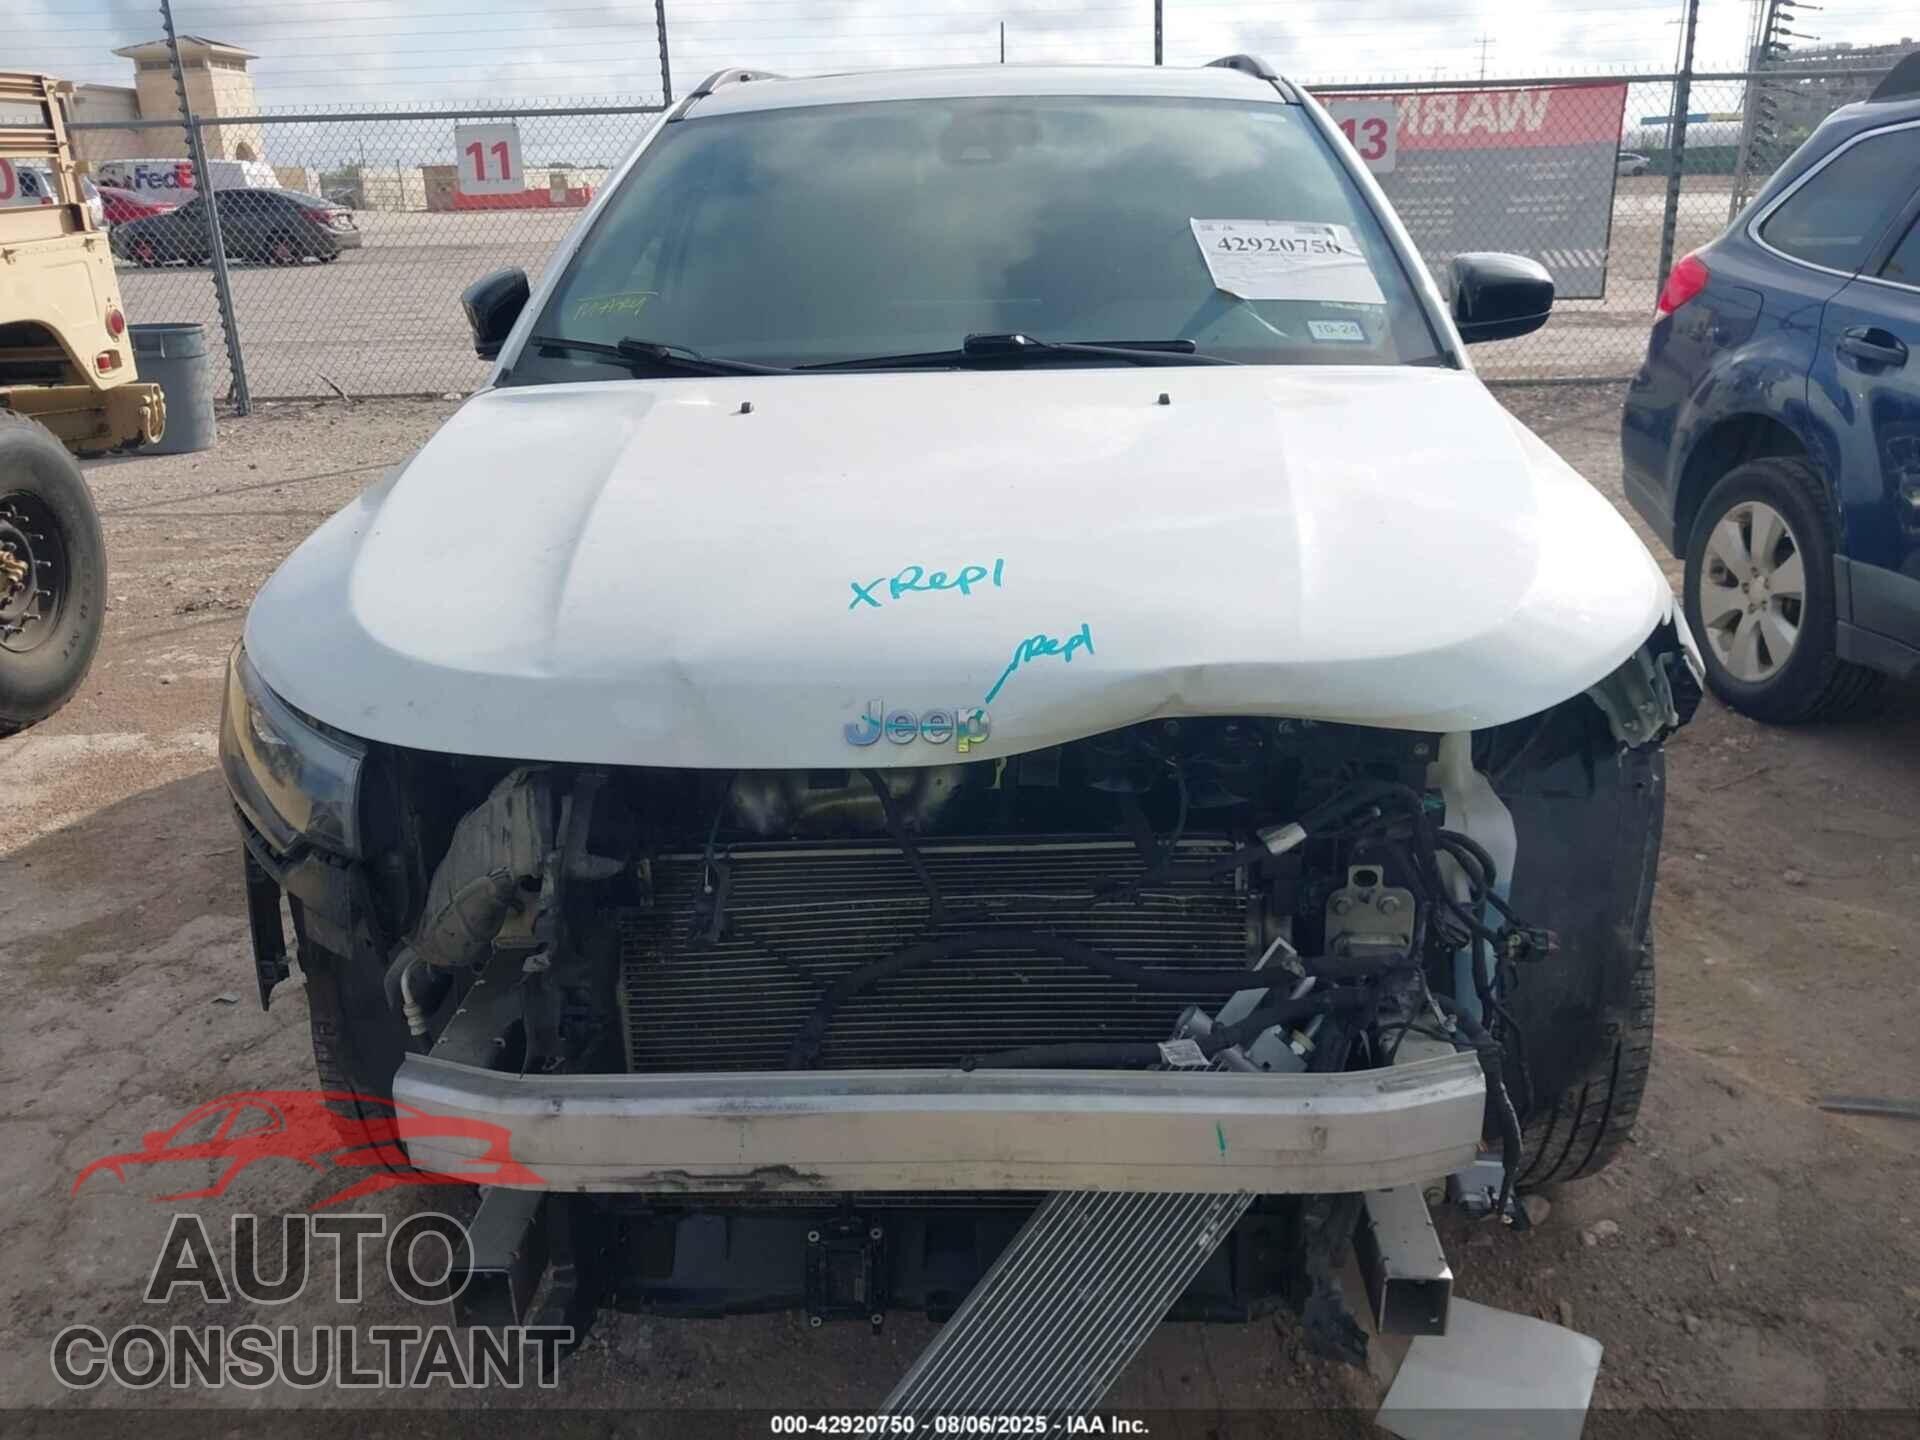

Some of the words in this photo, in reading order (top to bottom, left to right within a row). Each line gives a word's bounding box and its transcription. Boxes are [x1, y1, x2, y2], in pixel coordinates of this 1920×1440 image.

[134, 163, 194, 190] FedE
[465, 141, 512, 181] 11
[845, 699, 992, 754] Jeep
